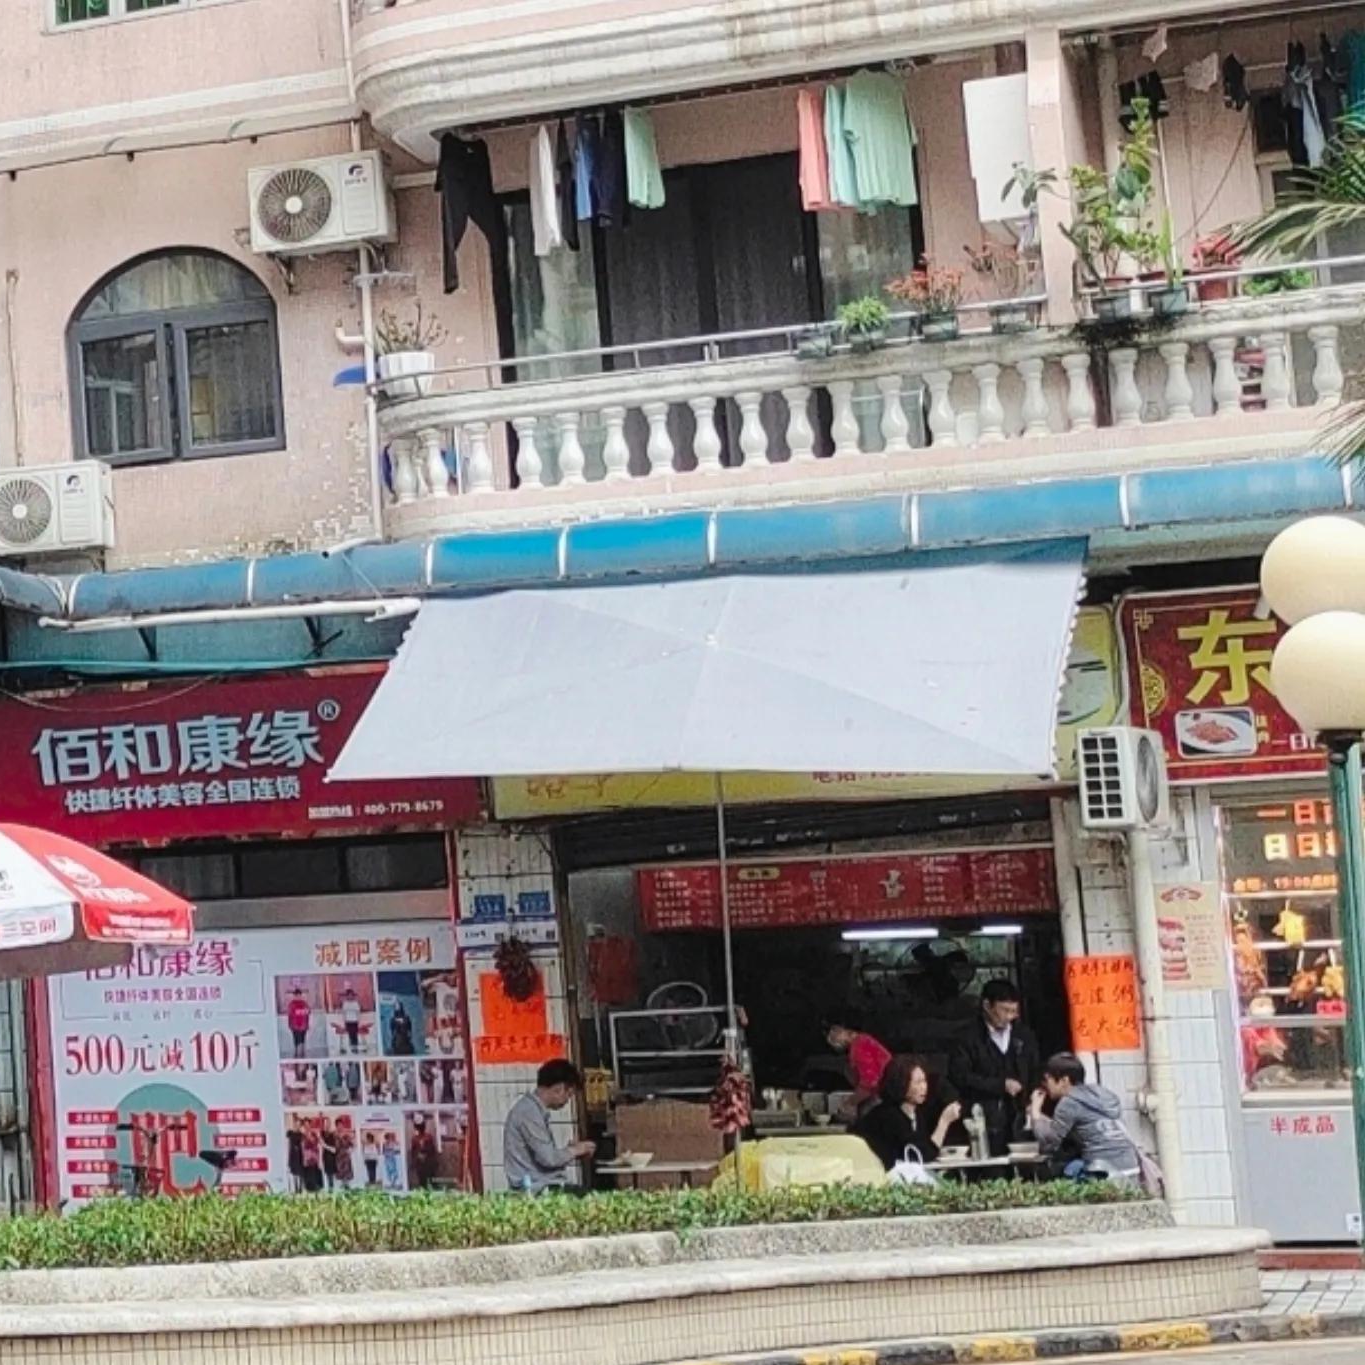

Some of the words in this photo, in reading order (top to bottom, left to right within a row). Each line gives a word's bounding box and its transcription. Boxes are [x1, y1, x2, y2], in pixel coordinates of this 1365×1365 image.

[31, 708, 325, 787] 佰和康缘
[65, 774, 302, 814] 快捷纤体美容全国连锁
[314, 936, 434, 967] 减肥案例
[64, 1028, 261, 1077] 500元减10斤
[1269, 1112, 1336, 1137] 半成品
